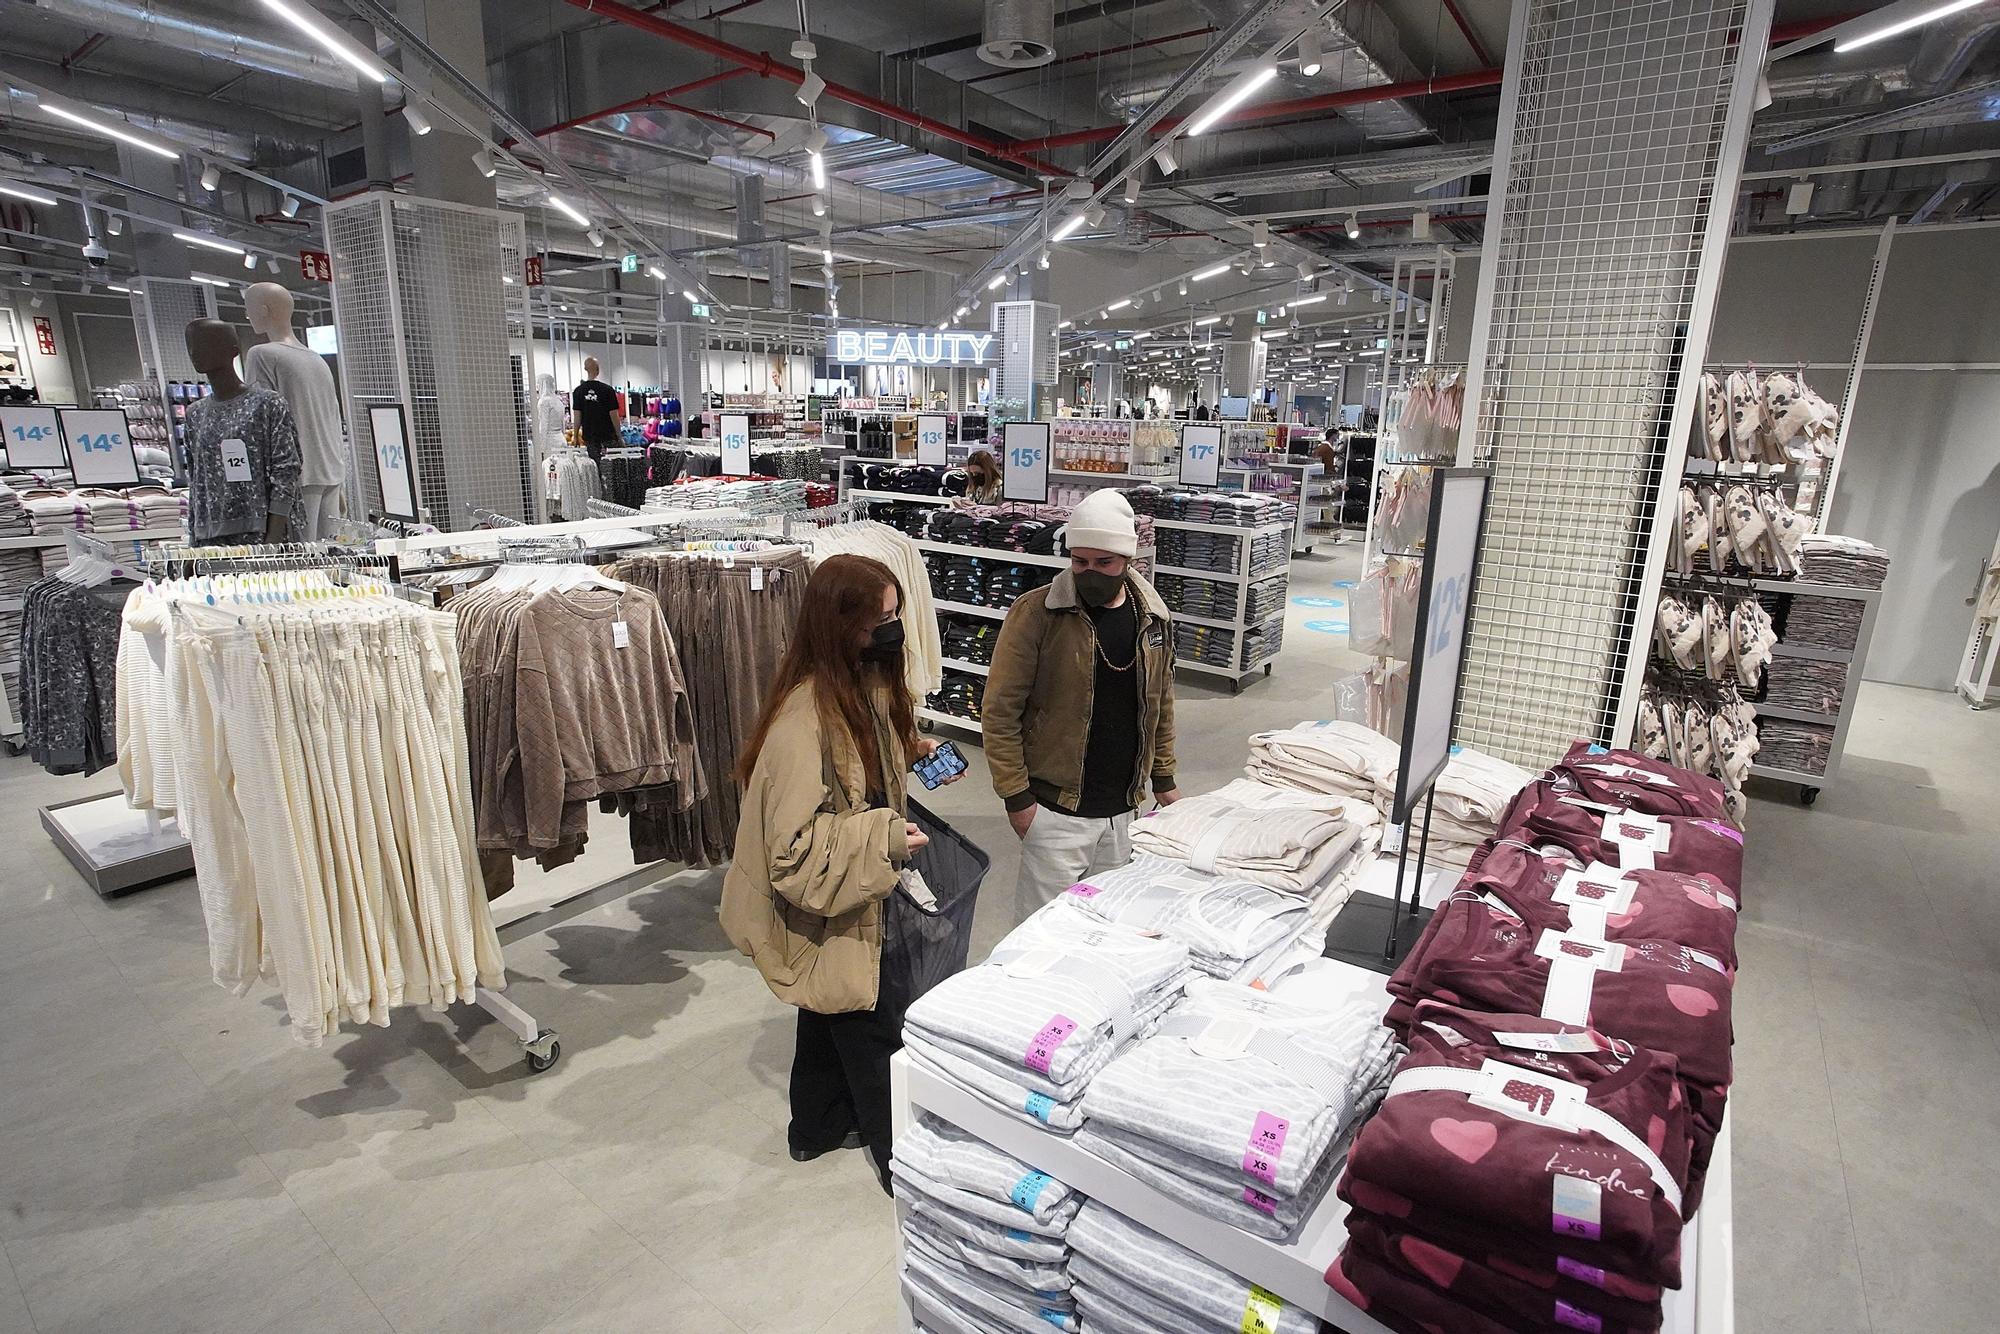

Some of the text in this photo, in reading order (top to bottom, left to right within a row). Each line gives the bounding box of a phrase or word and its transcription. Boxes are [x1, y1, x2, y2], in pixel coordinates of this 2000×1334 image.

[837, 330, 993, 365] BEAUTY
[12, 426, 53, 441] 14€
[922, 431, 943, 444] 13€
[77, 434, 122, 453] 14€
[725, 434, 745, 449] 15€
[381, 444, 403, 469] 12€
[1010, 447, 1042, 467] 15€
[1189, 444, 1214, 460] 17€
[228, 457, 245, 467] 12€
[1429, 572, 1467, 658] 12€
[1051, 1026, 1063, 1035] XS
[1035, 1047, 1046, 1058] XS
[1535, 1051, 1548, 1061] XS
[1262, 1130, 1277, 1140] XS
[1253, 1159, 1268, 1171] XS
[1020, 1197, 1026, 1205] S
[1254, 1190, 1267, 1204] XS
[1567, 1221, 1586, 1233] XS
[1255, 1318, 1264, 1329] M
